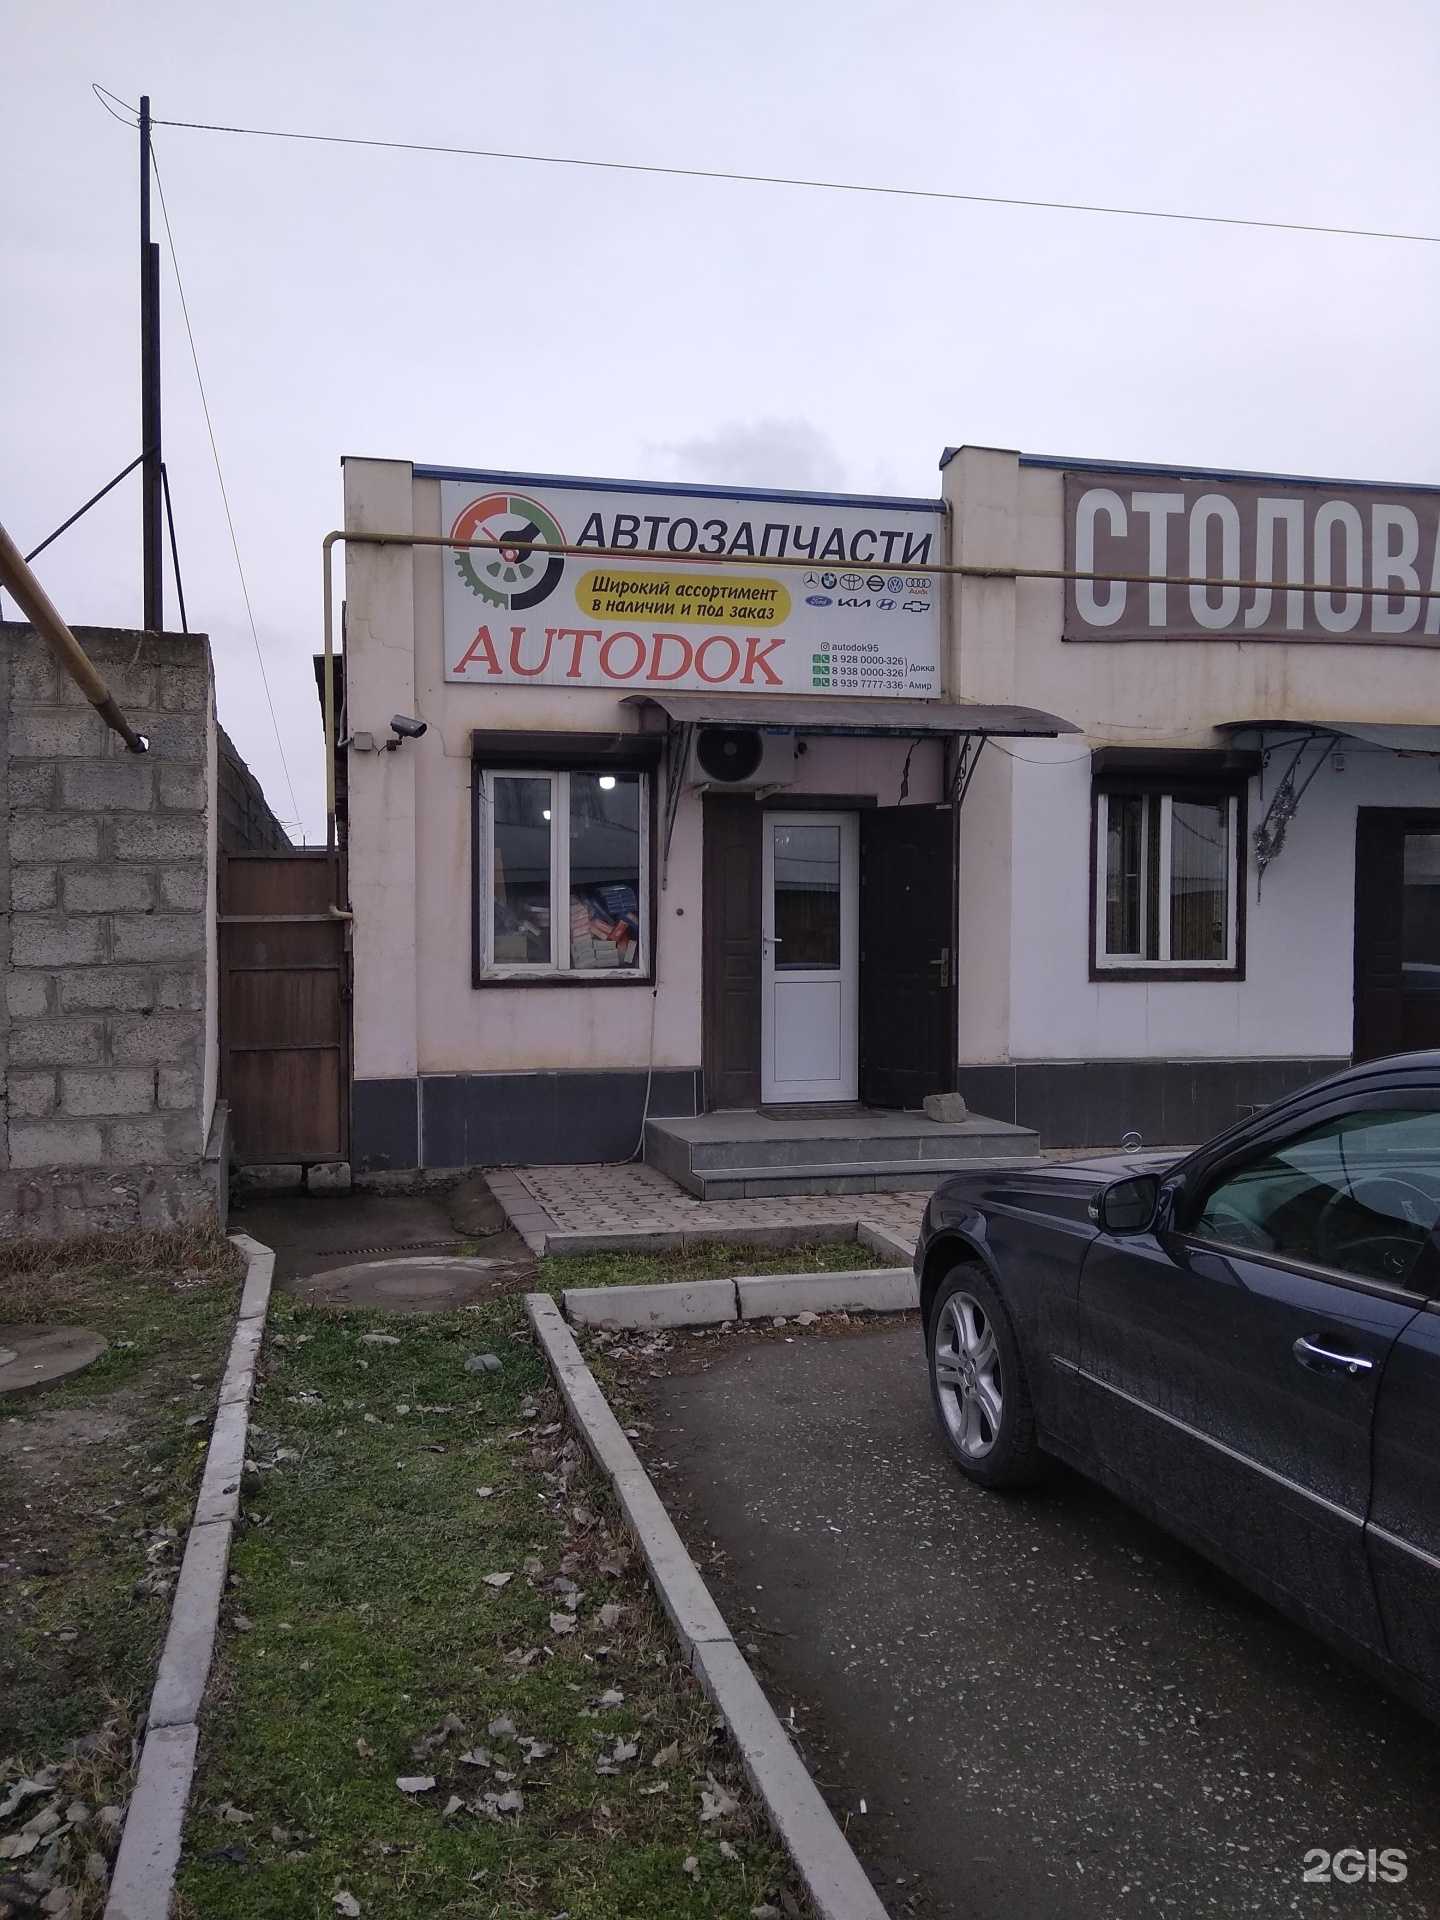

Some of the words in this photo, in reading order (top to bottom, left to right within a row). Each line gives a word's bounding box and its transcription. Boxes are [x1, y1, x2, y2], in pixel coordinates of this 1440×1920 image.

[576, 512, 933, 566] АВТОЗАПЧАСТИ
[591, 574, 670, 597] Широкий
[675, 583, 779, 602] ассортимент
[591, 600, 601, 612] в
[604, 600, 676, 616] наличии
[679, 603, 692, 616] и
[695, 604, 725, 619] под
[729, 606, 776, 620] заказ
[831, 643, 879, 653] autodok95
[453, 625, 787, 686] AUTODOK
[831, 655, 838, 663] 8
[841, 655, 858, 664] 928
[860, 656, 904, 665] 0000-326
[831, 667, 838, 675] 8
[841, 667, 858, 676] 938
[860, 668, 904, 678] 0000-326
[909, 663, 936, 673] Докка
[831, 678, 838, 687] 8
[841, 679, 858, 688] 939
[860, 680, 904, 690] 7777-336
[908, 682, 933, 692] Амир
